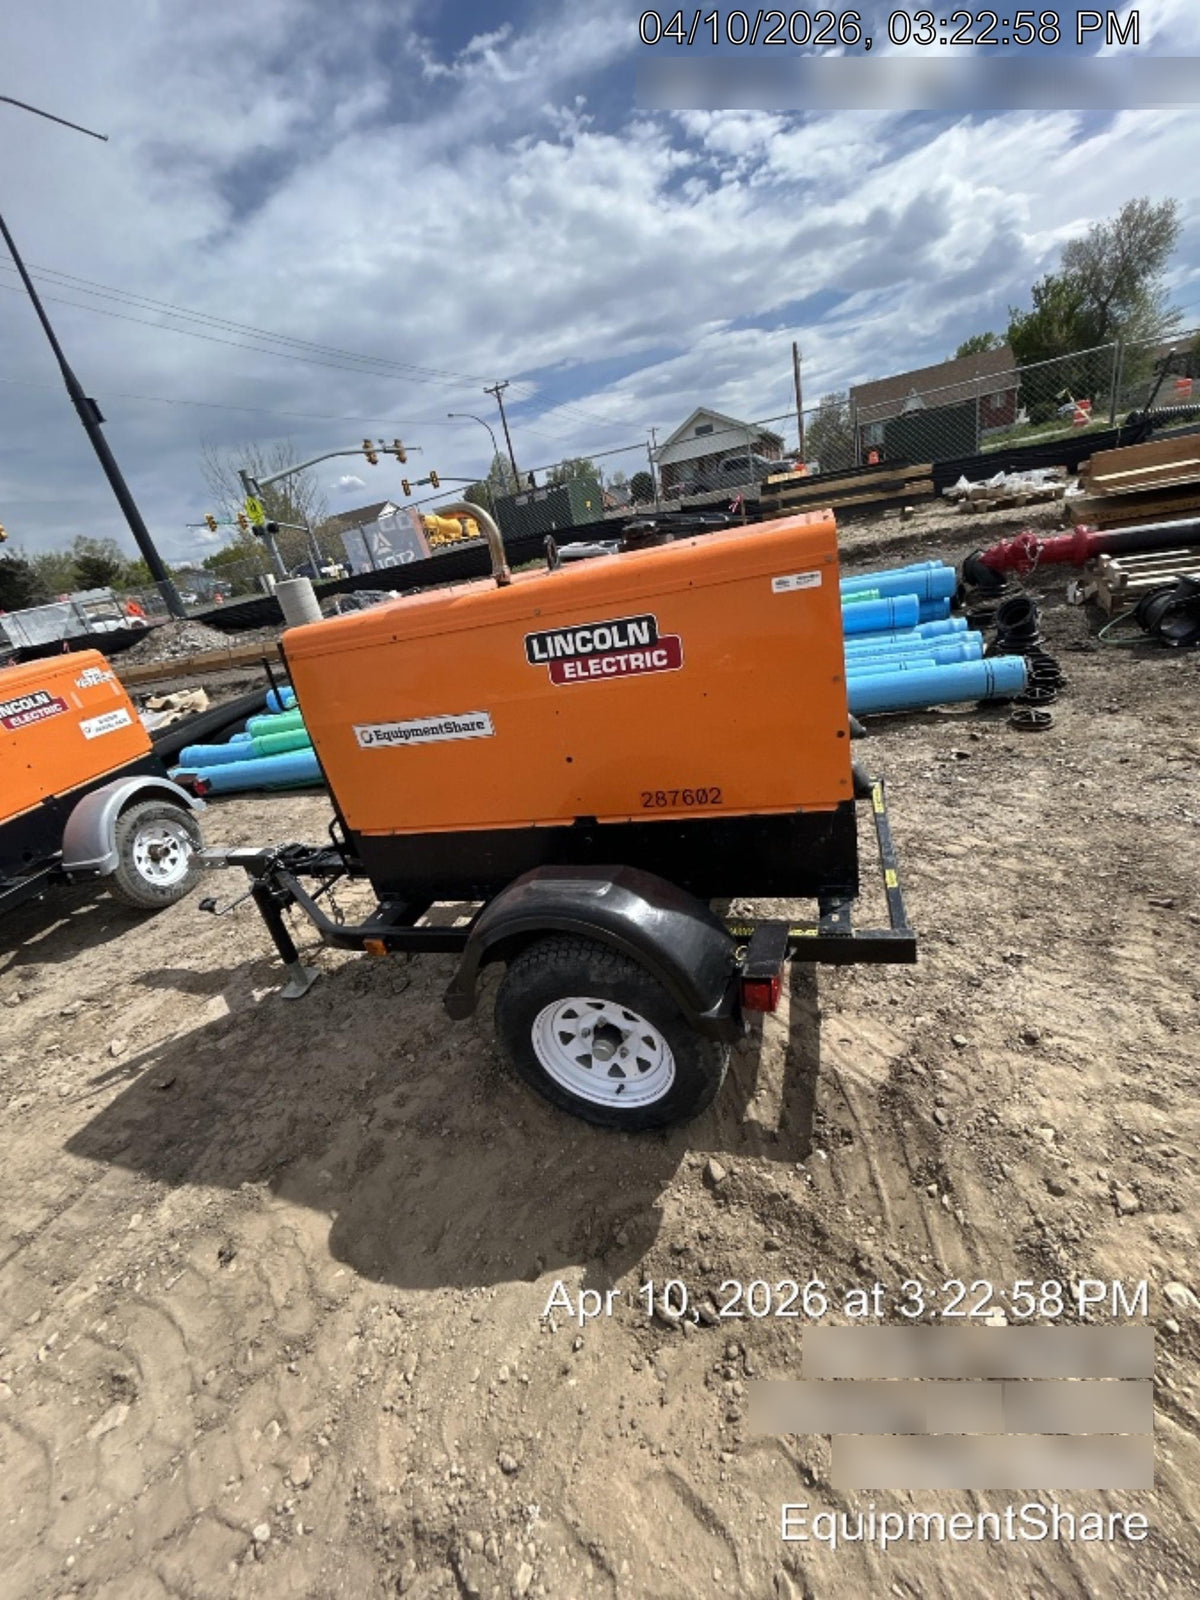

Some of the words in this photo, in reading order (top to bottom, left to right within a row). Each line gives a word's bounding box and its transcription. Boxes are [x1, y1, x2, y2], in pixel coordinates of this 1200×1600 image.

[531, 621, 650, 660] LINCOLN
[563, 650, 668, 679] ELECTRIC
[0, 692, 51, 719] NCOLN
[9, 703, 63, 727] ELECTRIC
[373, 720, 485, 742] EquipmentShare
[641, 787, 723, 808] 287602
